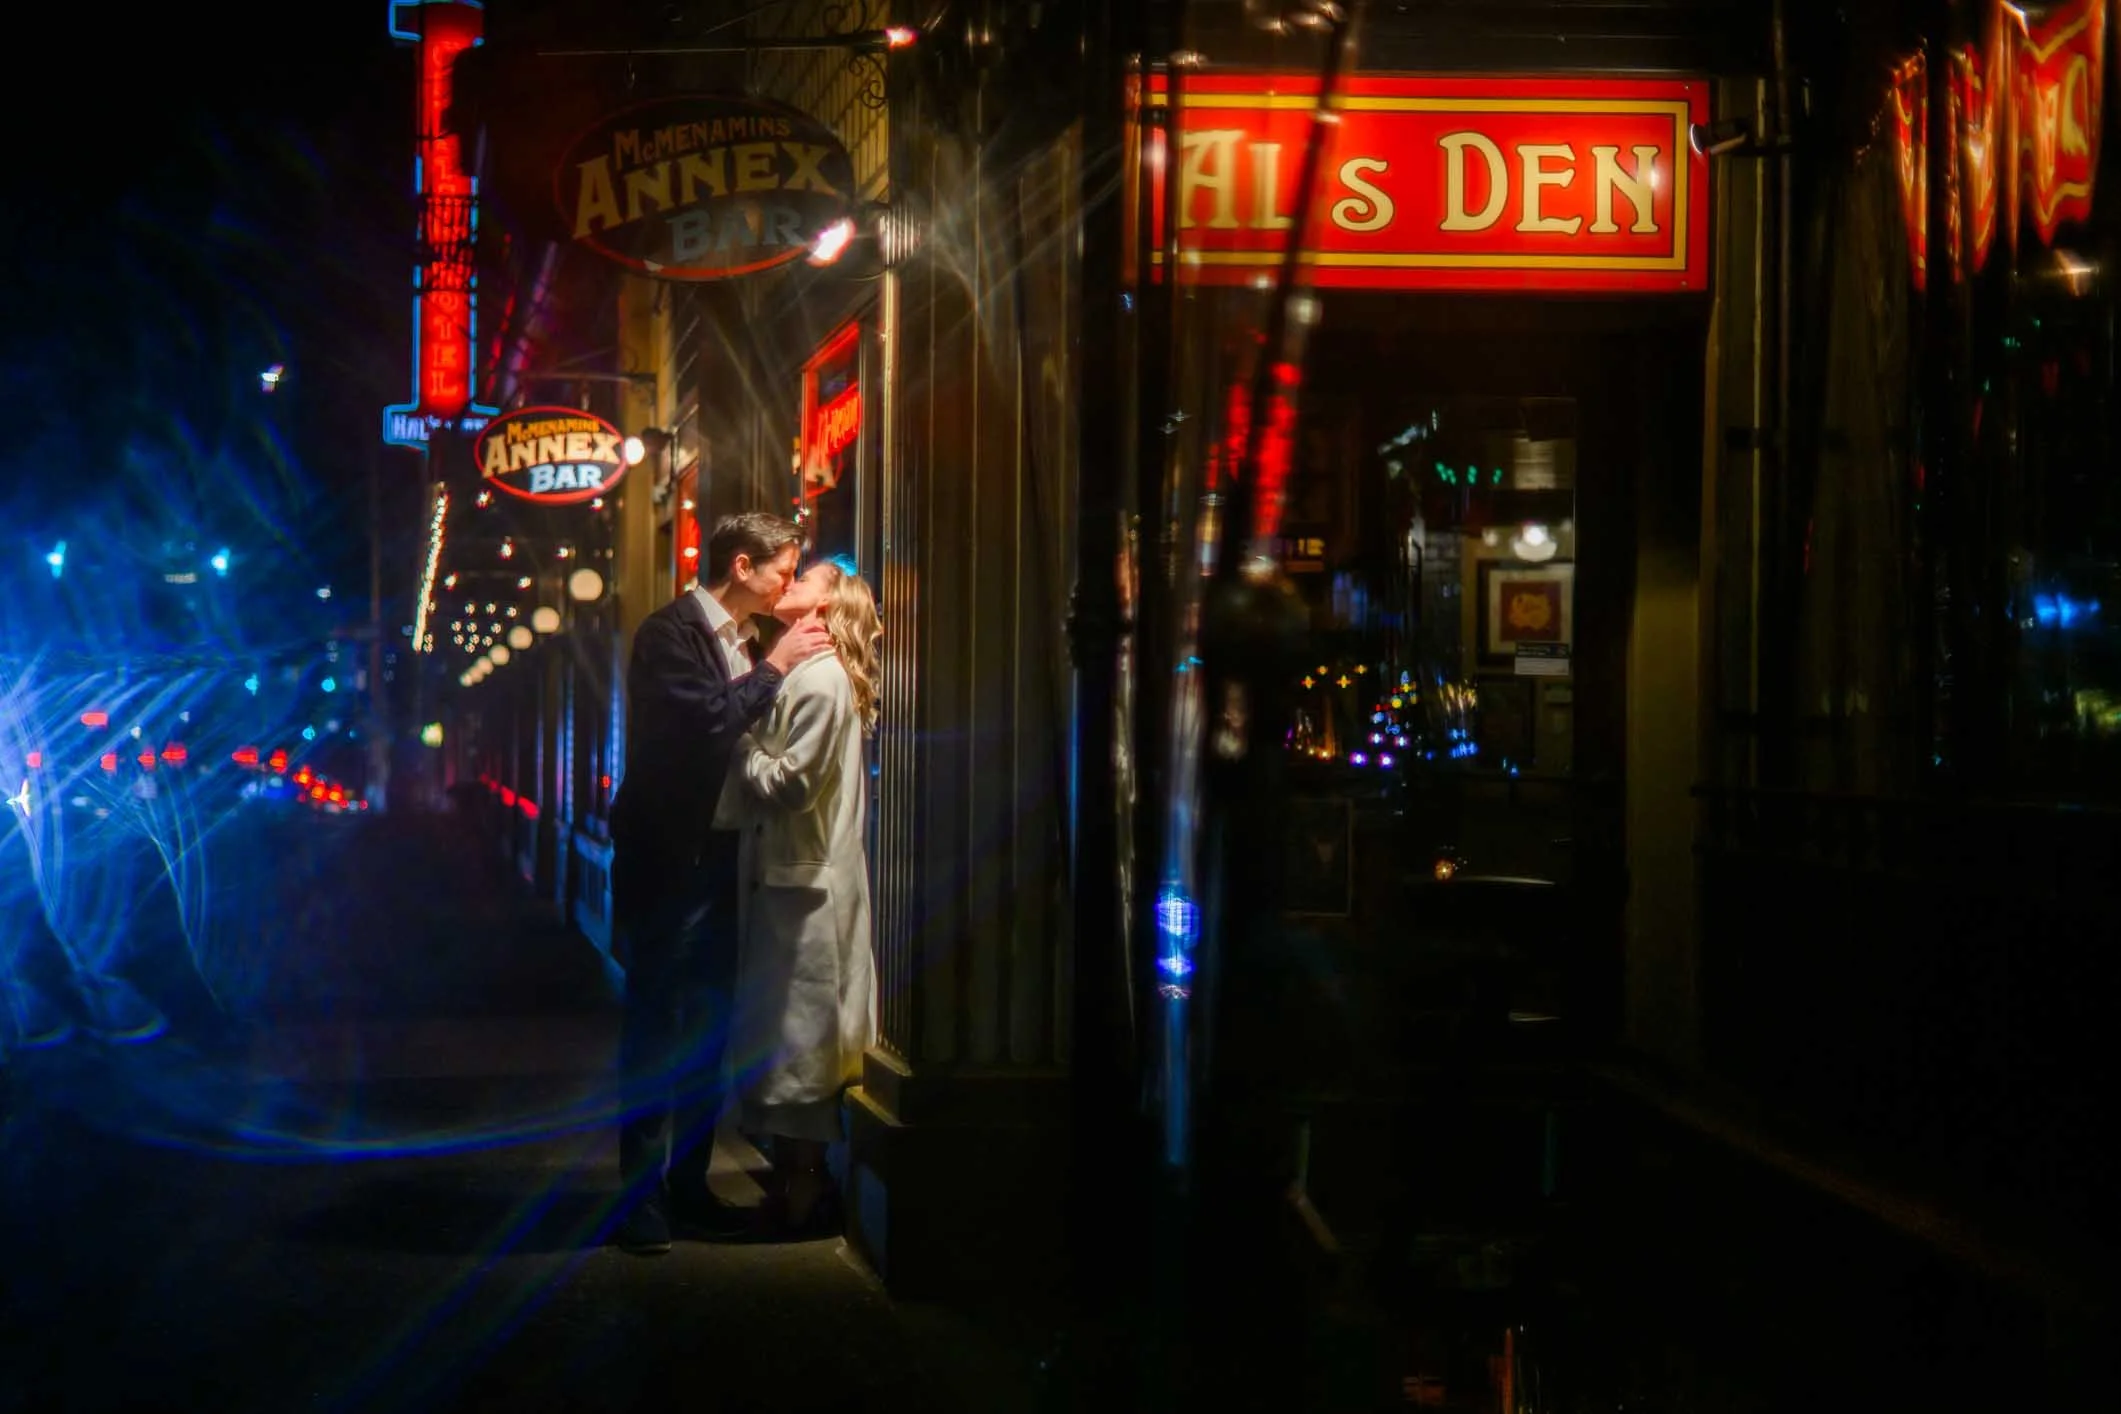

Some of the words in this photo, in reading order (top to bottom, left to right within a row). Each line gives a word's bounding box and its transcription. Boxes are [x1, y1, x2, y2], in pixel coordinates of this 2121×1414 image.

[572, 141, 838, 240] ANNEX
[1436, 130, 1661, 234] DEN
[665, 206, 806, 262] BAR
[482, 431, 622, 479] ANNEX
[530, 464, 603, 493] BAR
